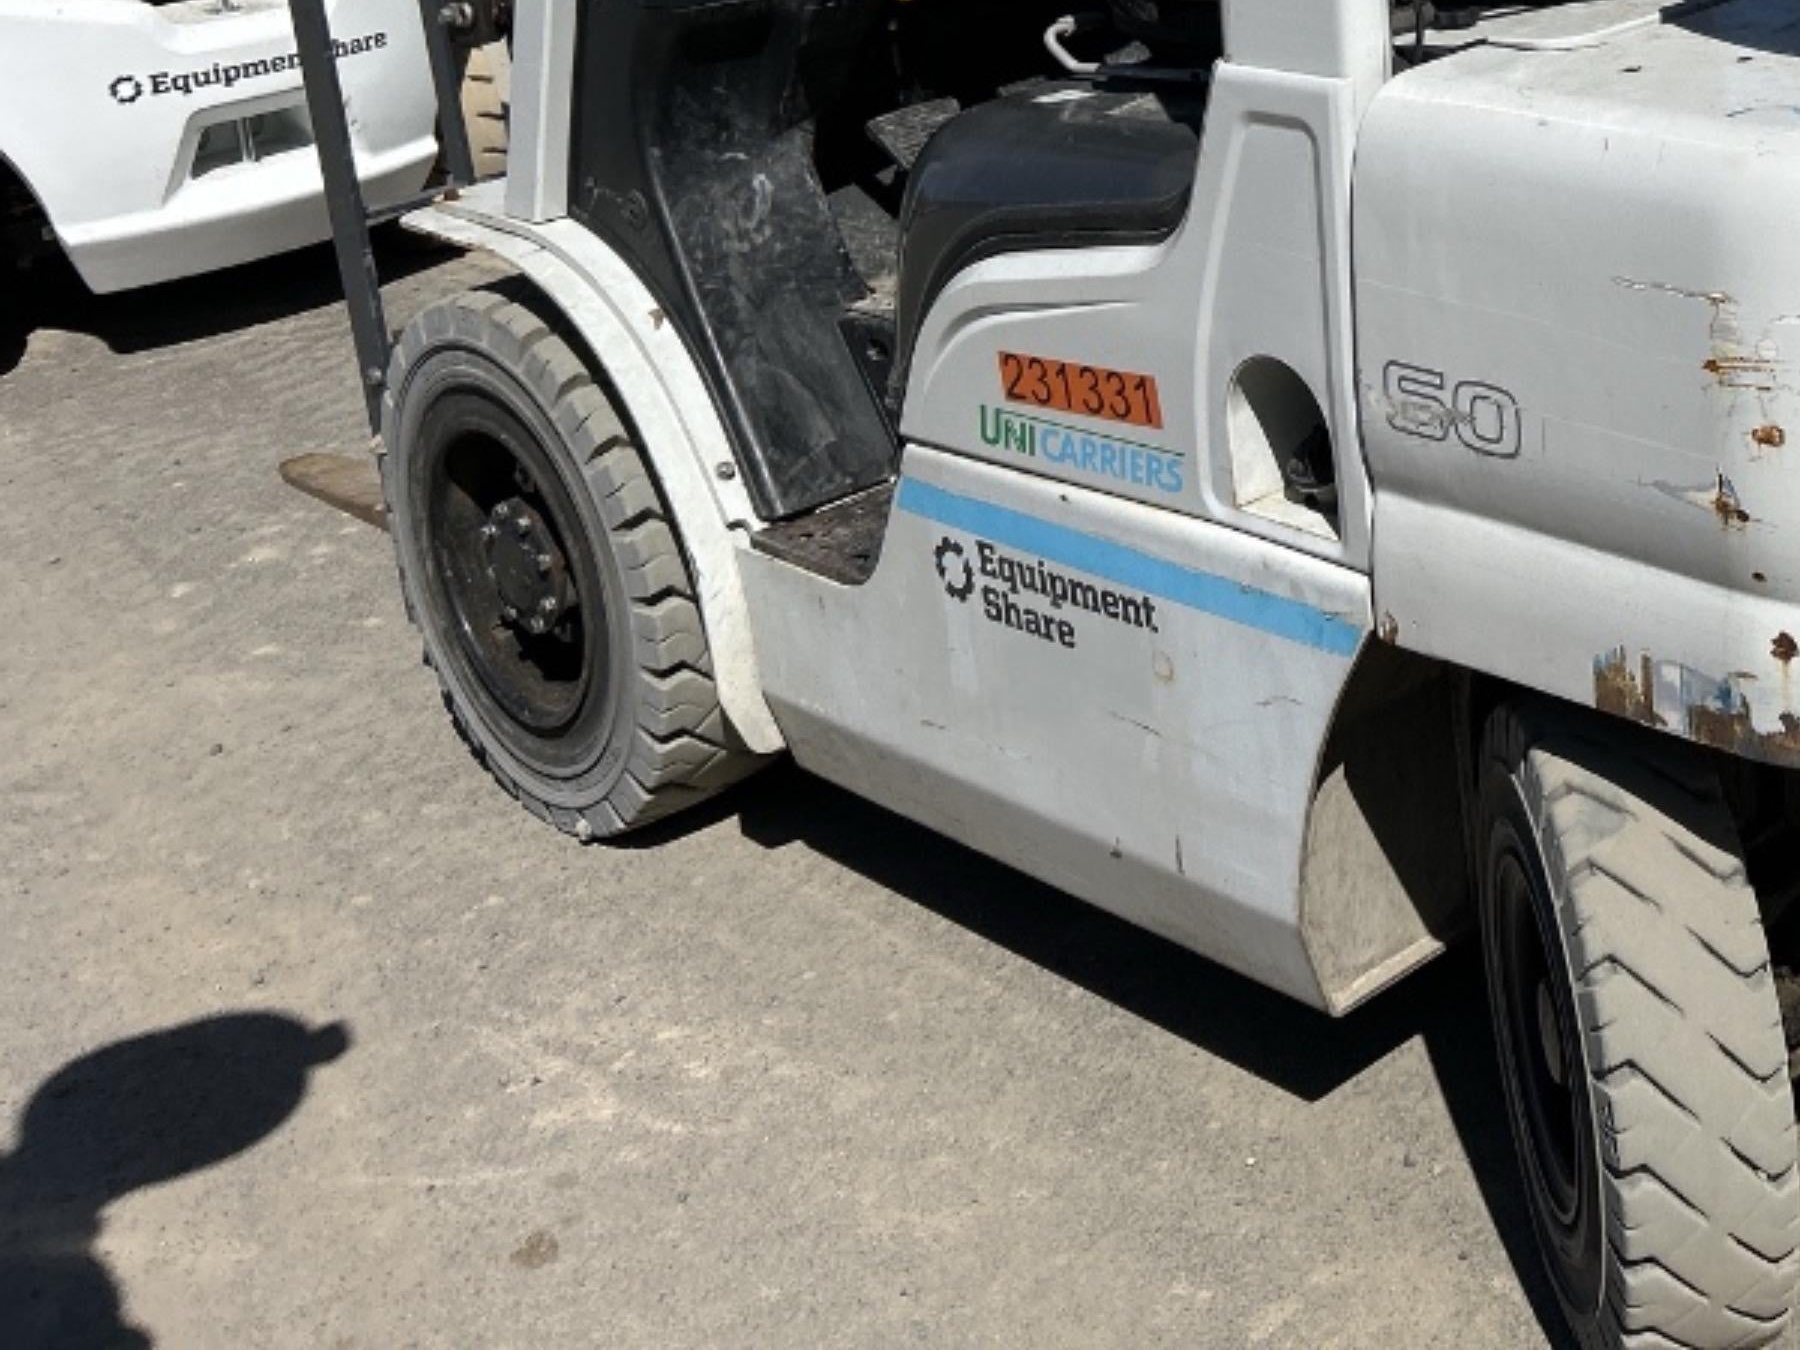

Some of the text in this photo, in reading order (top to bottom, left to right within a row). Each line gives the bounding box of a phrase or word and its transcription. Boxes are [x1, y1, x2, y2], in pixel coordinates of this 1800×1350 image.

[1003, 353, 1155, 425] 231331
[976, 539, 1158, 633] Equipment
[982, 584, 1076, 649] Share
